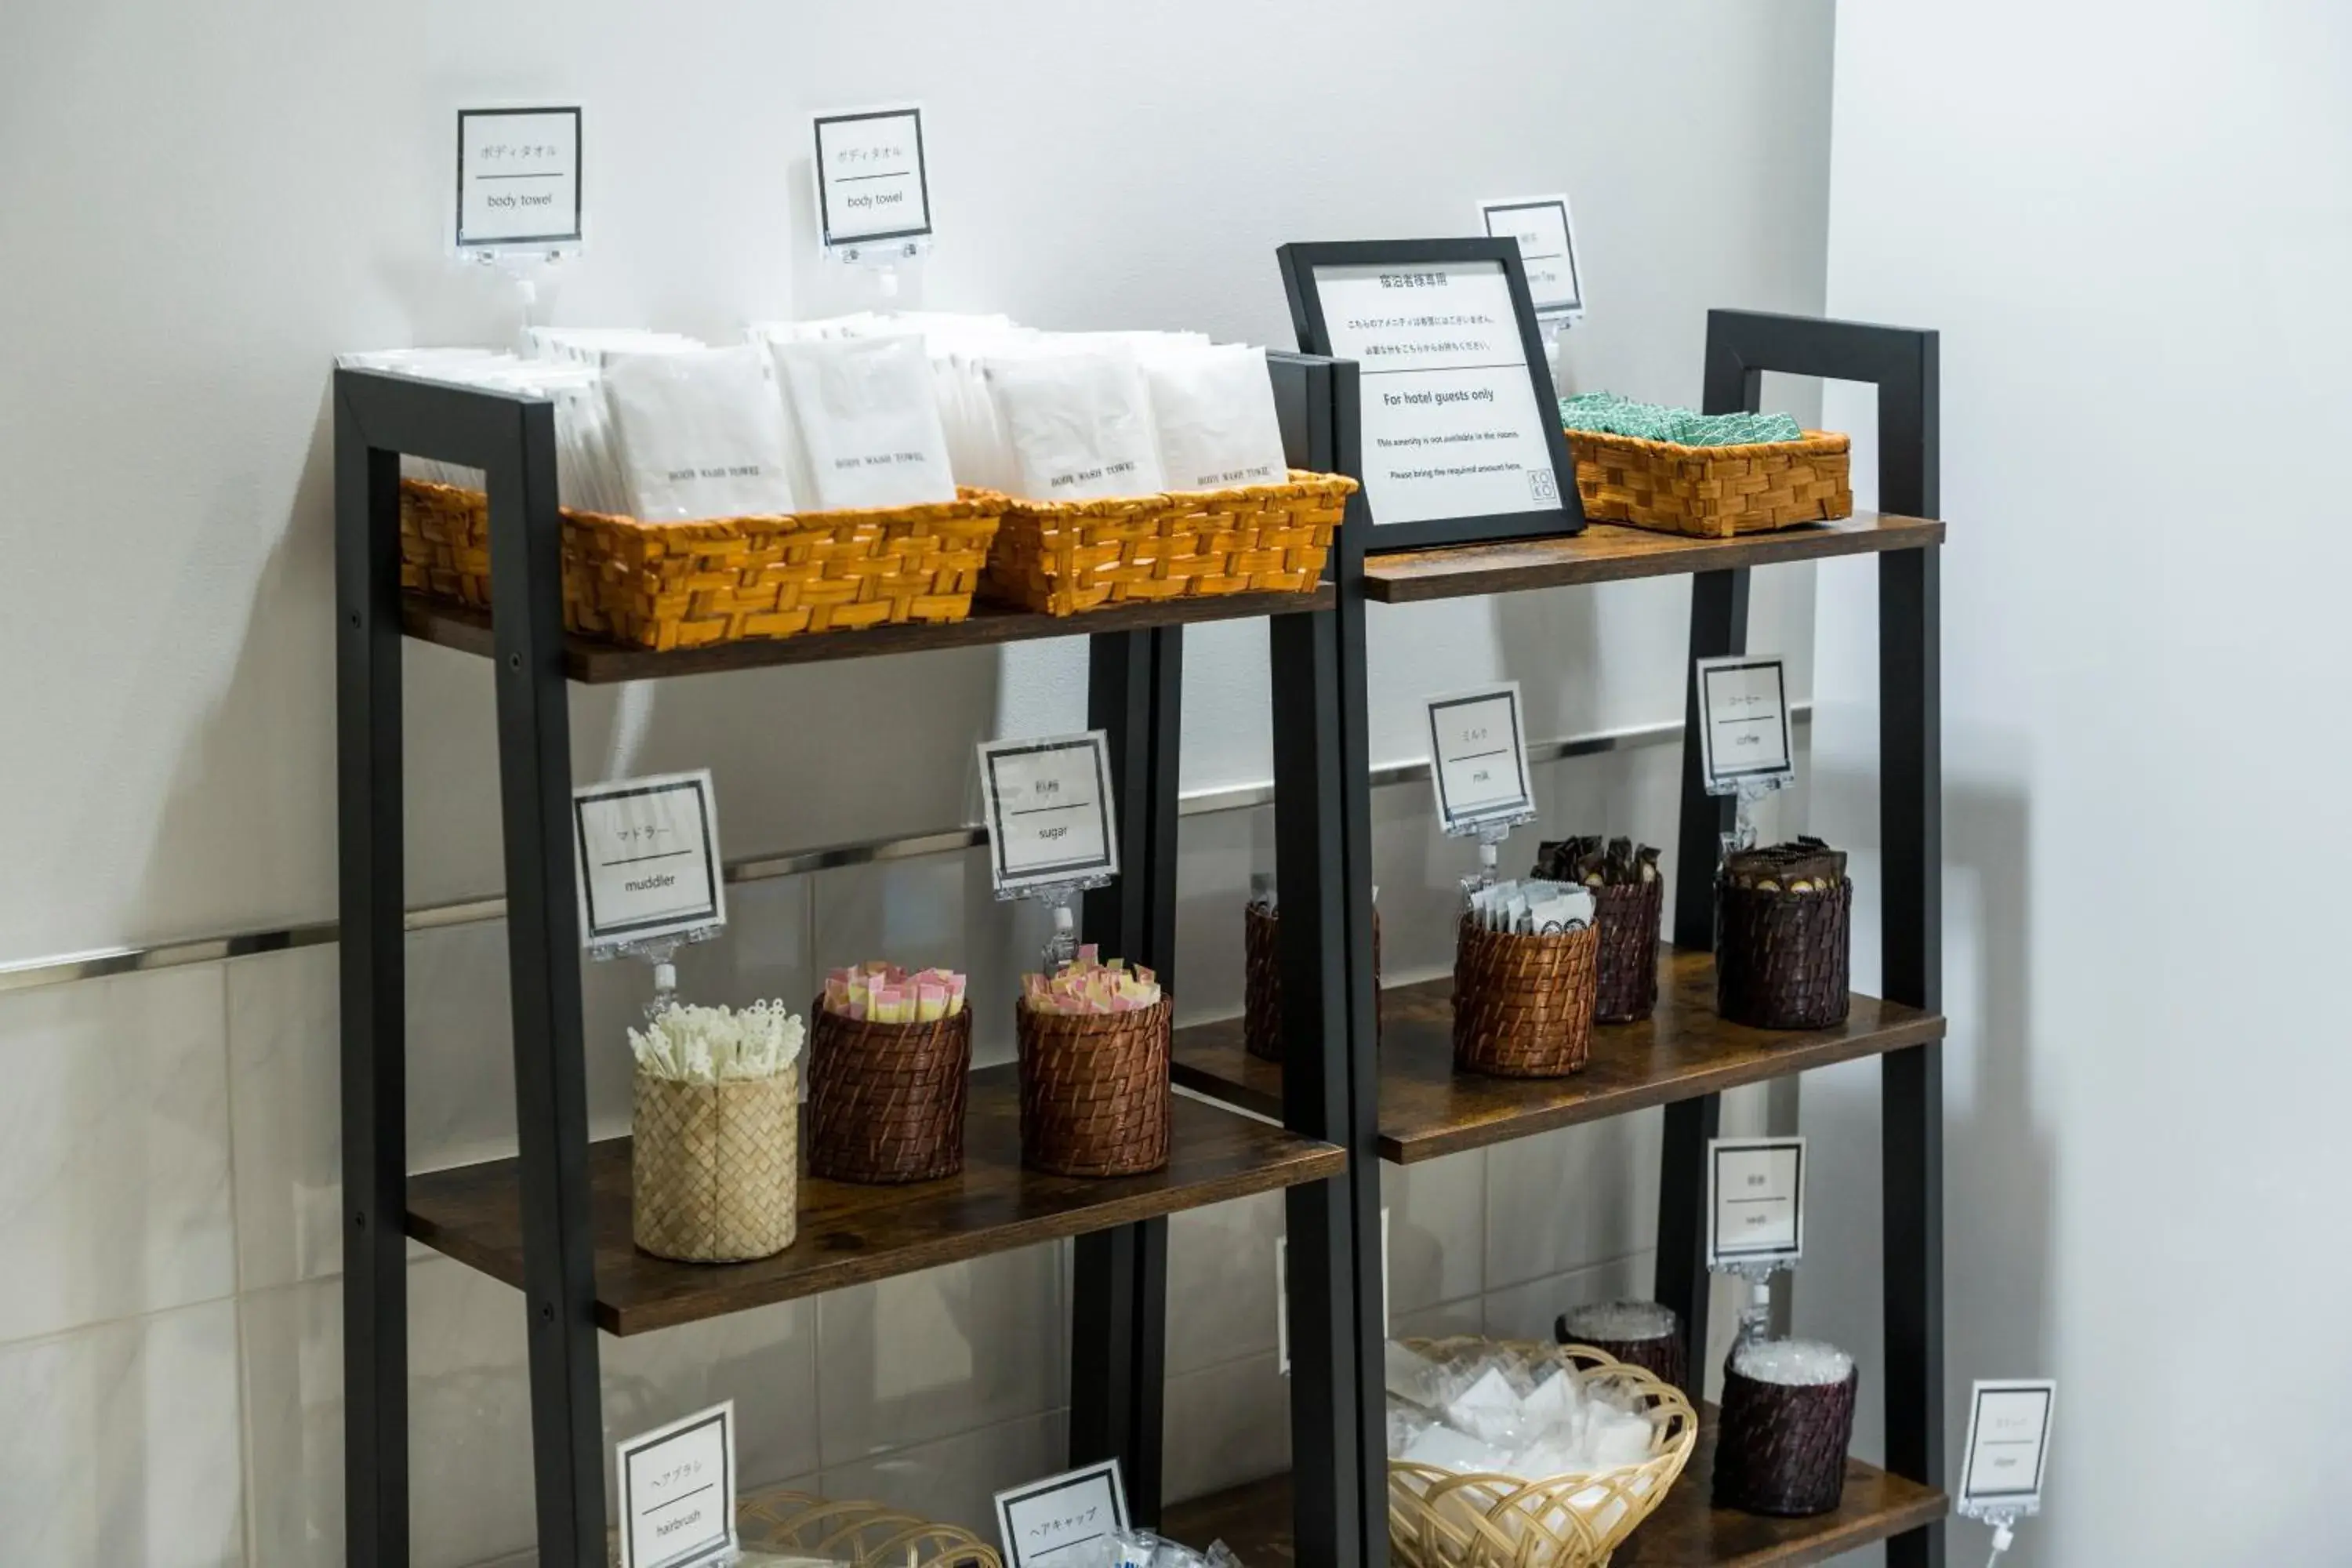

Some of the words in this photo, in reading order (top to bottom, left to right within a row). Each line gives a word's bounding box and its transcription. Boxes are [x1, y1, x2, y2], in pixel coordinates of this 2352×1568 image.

[488, 195, 516, 208] body
[521, 194, 552, 206] towel
[848, 196, 873, 209] body
[876, 191, 902, 204] towel
[1384, 393, 1401, 405] For
[1405, 391, 1432, 404] hotel
[1435, 391, 1469, 405] guests
[1472, 389, 1494, 402] only
[1377, 438, 1392, 447] This
[1390, 470, 1412, 479] Please
[1414, 468, 1433, 478] bring
[1039, 826, 1069, 840] sugar
[625, 874, 676, 891] muddler
[656, 1510, 702, 1537] hairbrush
[1029, 1506, 1098, 1537] ヘアキャップ
